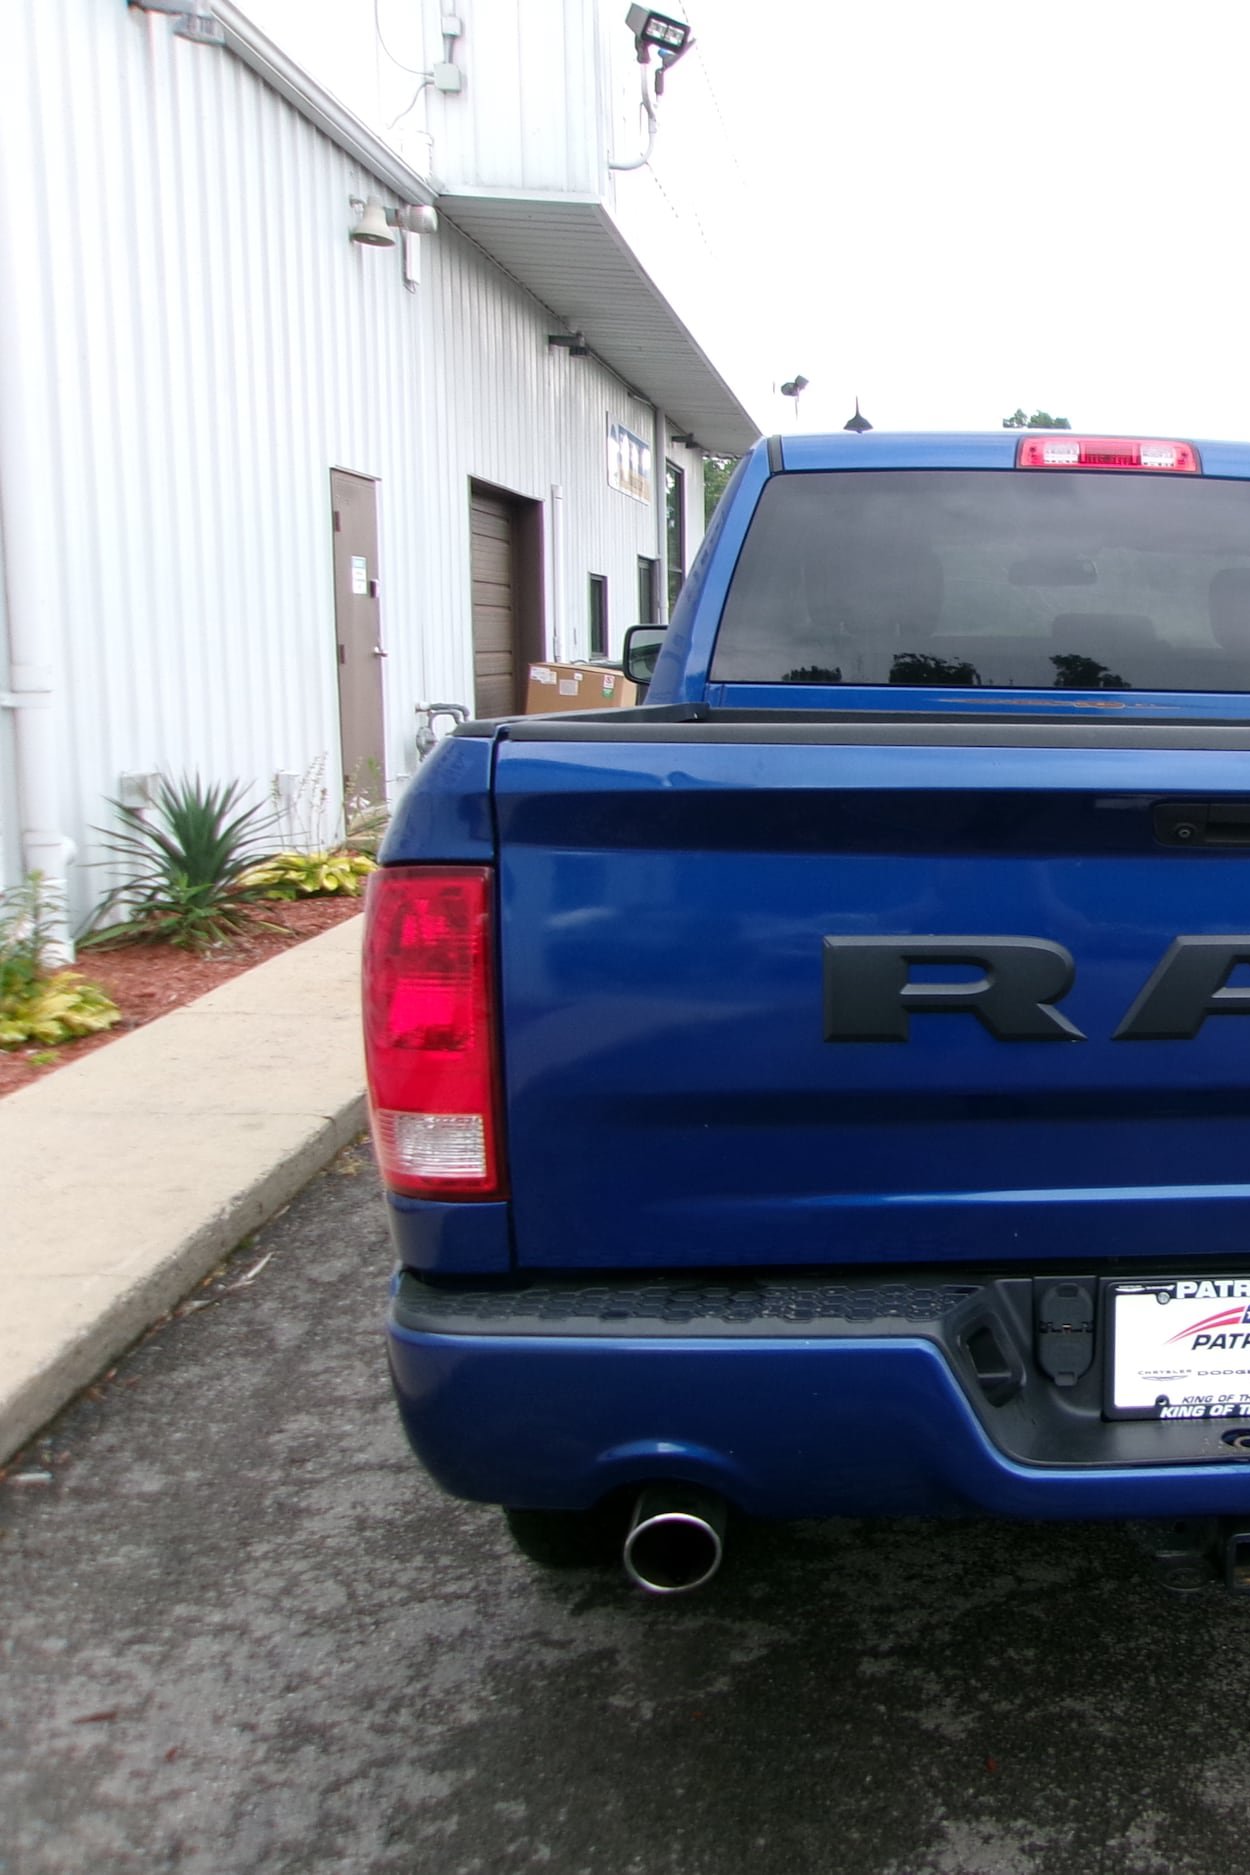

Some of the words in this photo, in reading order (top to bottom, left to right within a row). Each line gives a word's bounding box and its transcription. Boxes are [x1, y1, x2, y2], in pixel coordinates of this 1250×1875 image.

[1182, 1395, 1214, 1404] KING
[1218, 1394, 1235, 1402] OF
[1160, 1404, 1206, 1418] KING
[1209, 1404, 1235, 1416] OF
